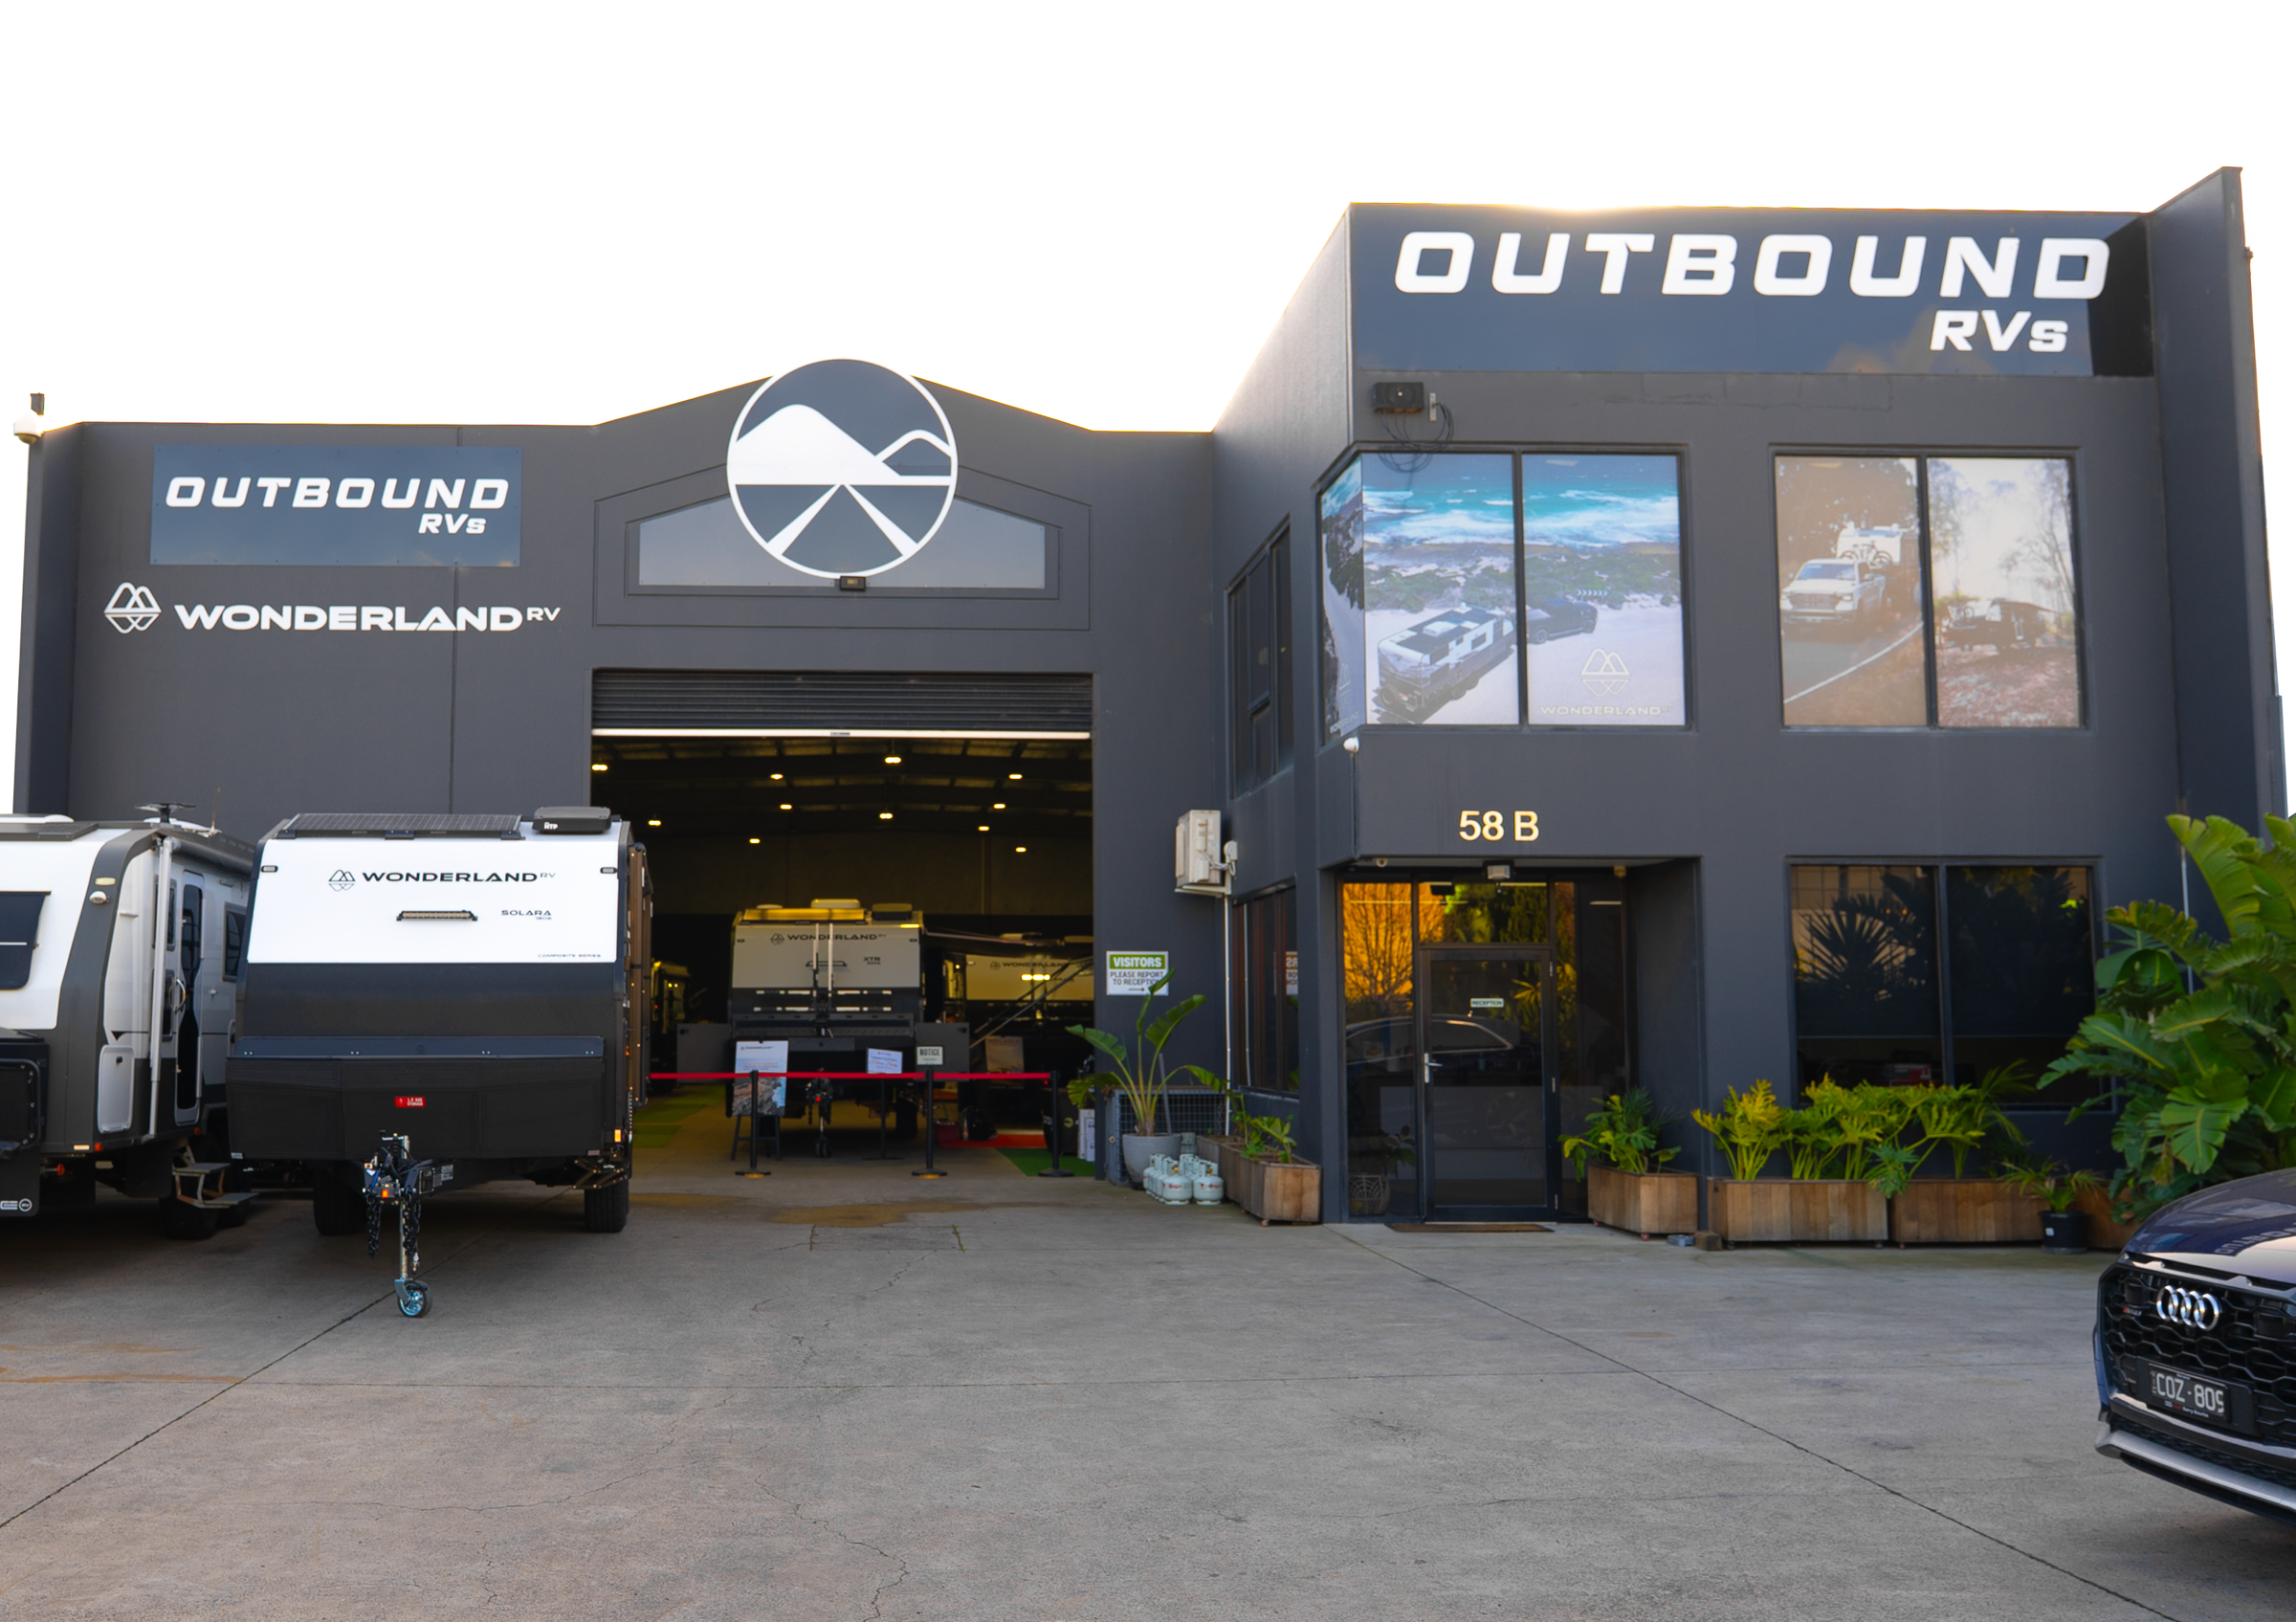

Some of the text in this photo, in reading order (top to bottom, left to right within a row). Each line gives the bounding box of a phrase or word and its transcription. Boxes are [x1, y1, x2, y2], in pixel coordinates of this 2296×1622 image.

[1395, 231, 2109, 300] OUTBOUND
[1930, 309, 2069, 353] RVs
[166, 477, 509, 509] OUTBOUND
[418, 513, 487, 534] RVs
[173, 604, 562, 632] WONDERLAND RV
[1539, 705, 1662, 716] WONDERLAND
[1459, 810, 1540, 842] 58 B
[362, 872, 538, 882] WONDERLAND
[1113, 956, 1162, 967] VISITORS
